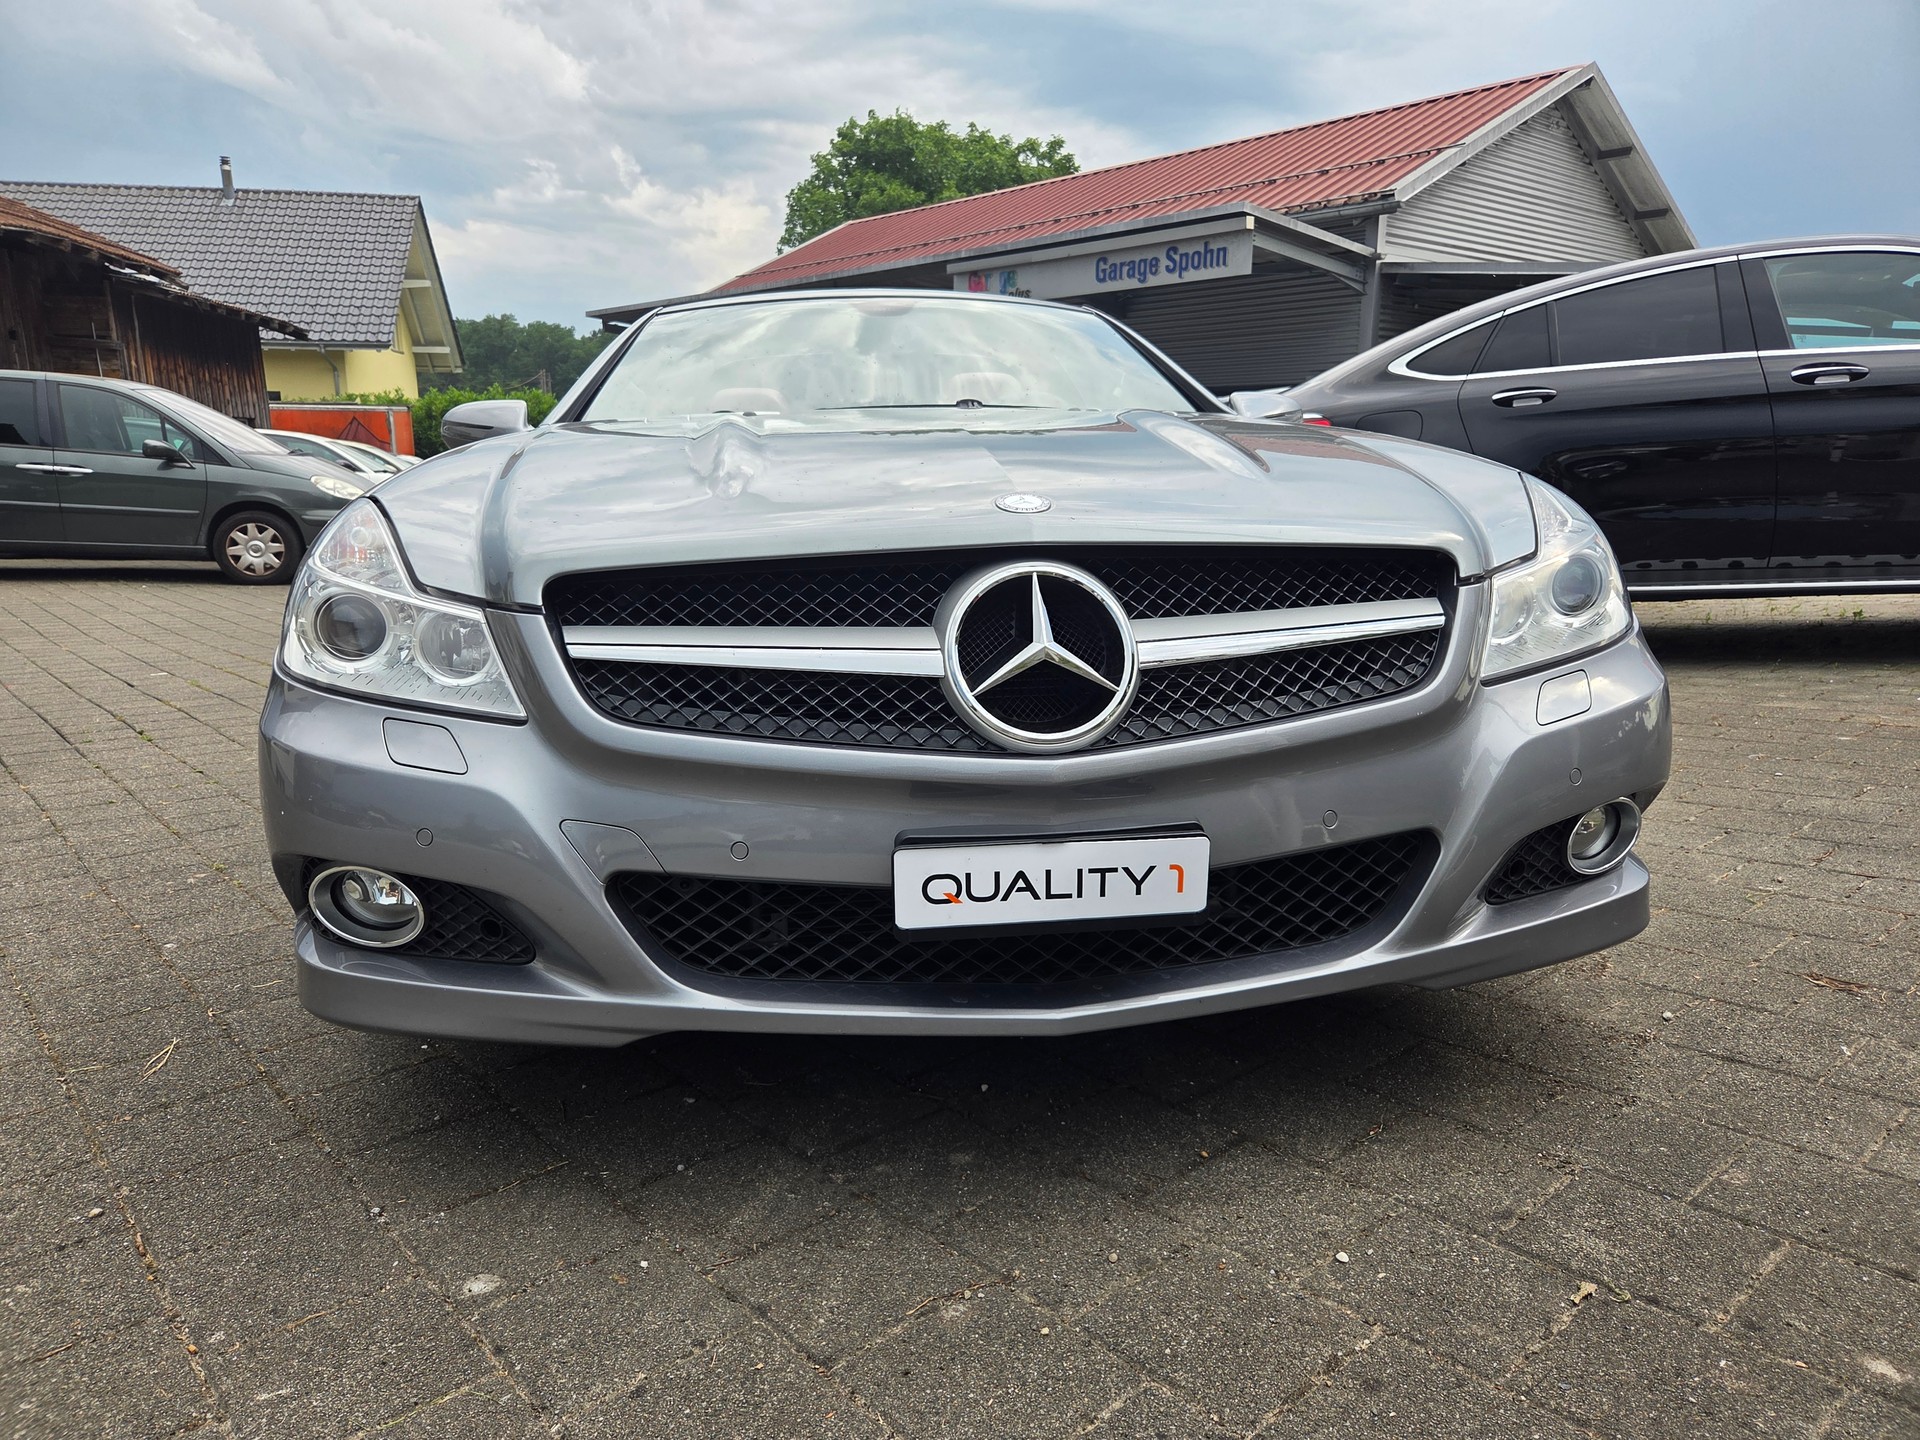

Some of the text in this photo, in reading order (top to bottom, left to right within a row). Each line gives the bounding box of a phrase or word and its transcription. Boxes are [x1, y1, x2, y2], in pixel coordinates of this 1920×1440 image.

[1095, 241, 1228, 284] Garage Spohn
[921, 863, 1185, 905] QUALITY 1
